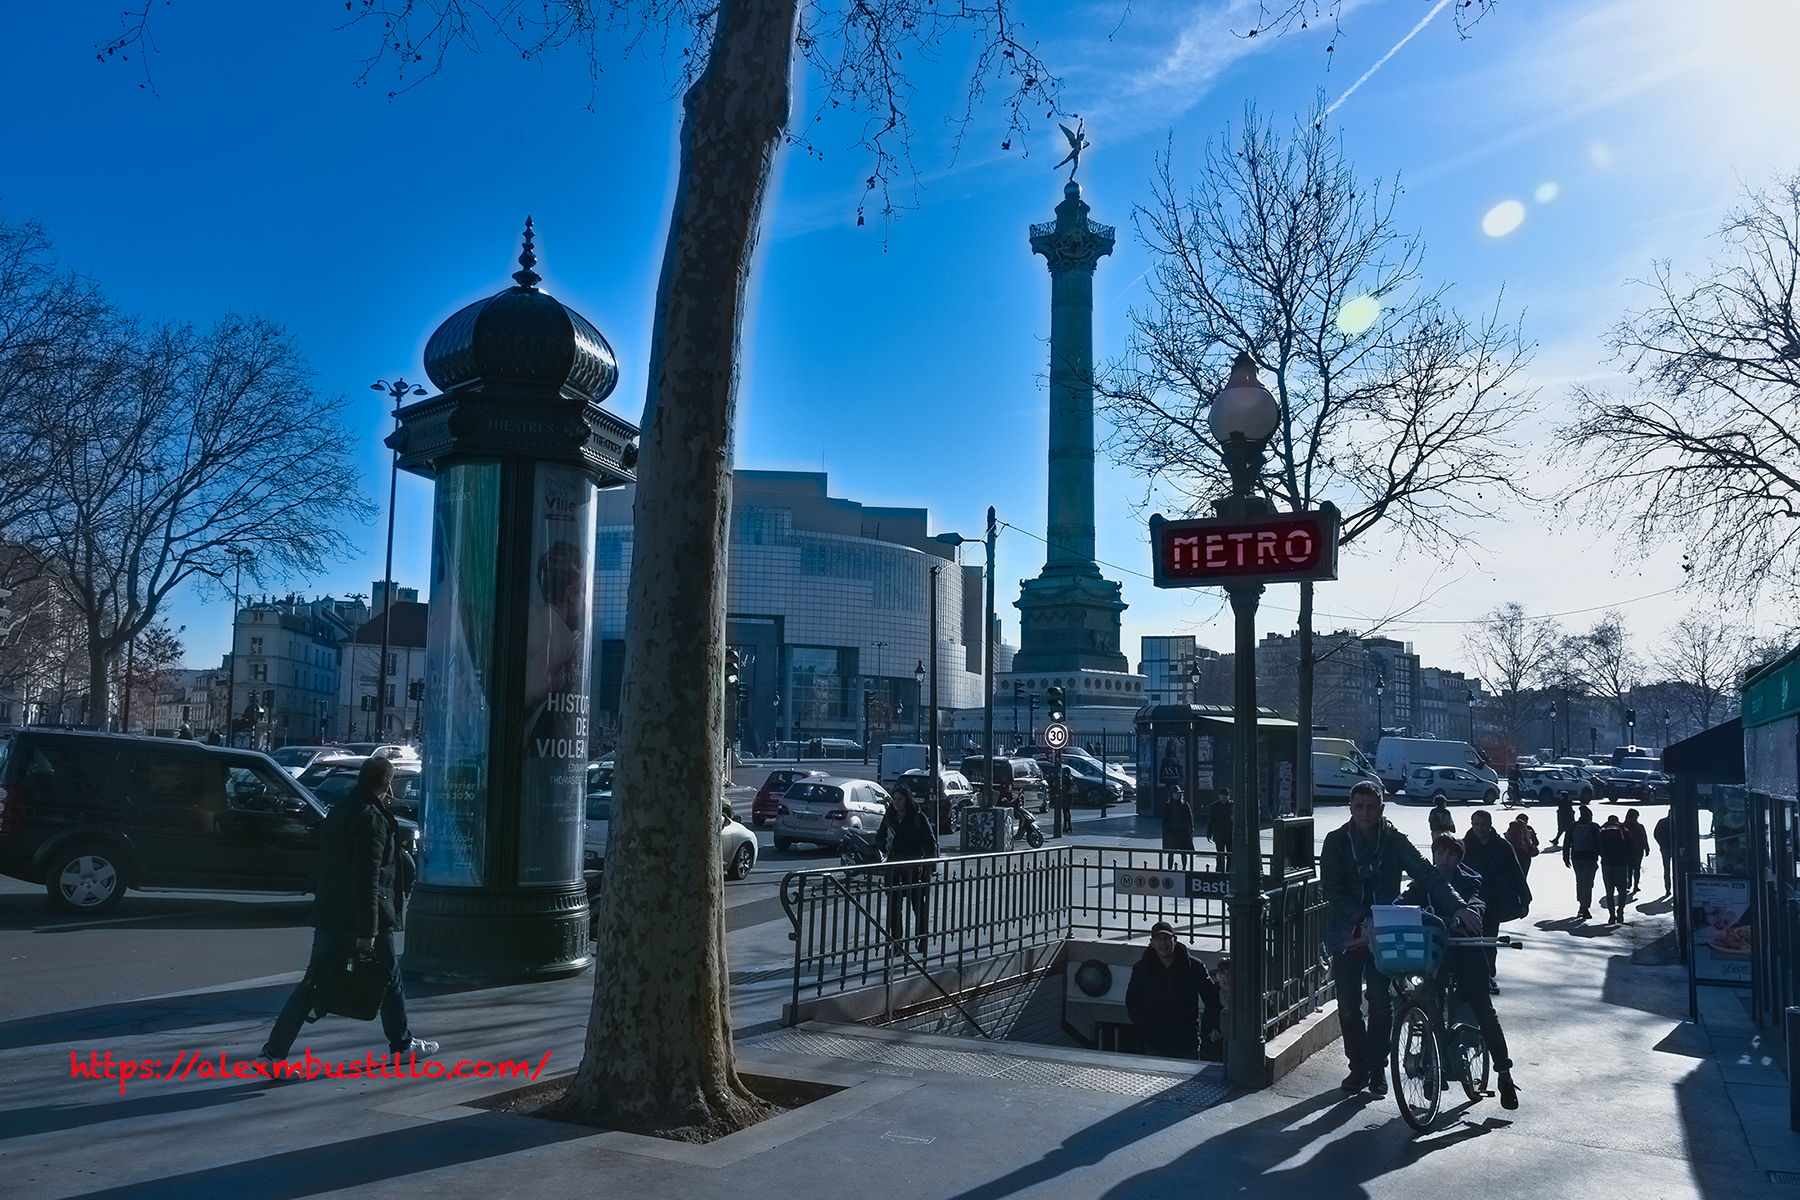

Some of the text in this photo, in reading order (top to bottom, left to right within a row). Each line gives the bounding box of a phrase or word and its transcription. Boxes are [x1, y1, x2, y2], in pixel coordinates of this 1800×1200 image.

[486, 418, 554, 434] THEATRES
[592, 432, 622, 455] THEATRES
[545, 496, 577, 513] Ville
[1173, 529, 1313, 570] METRO
[1050, 731, 1063, 742] 30
[452, 792, 475, 801] 2020
[1192, 878, 1231, 894] Basti
